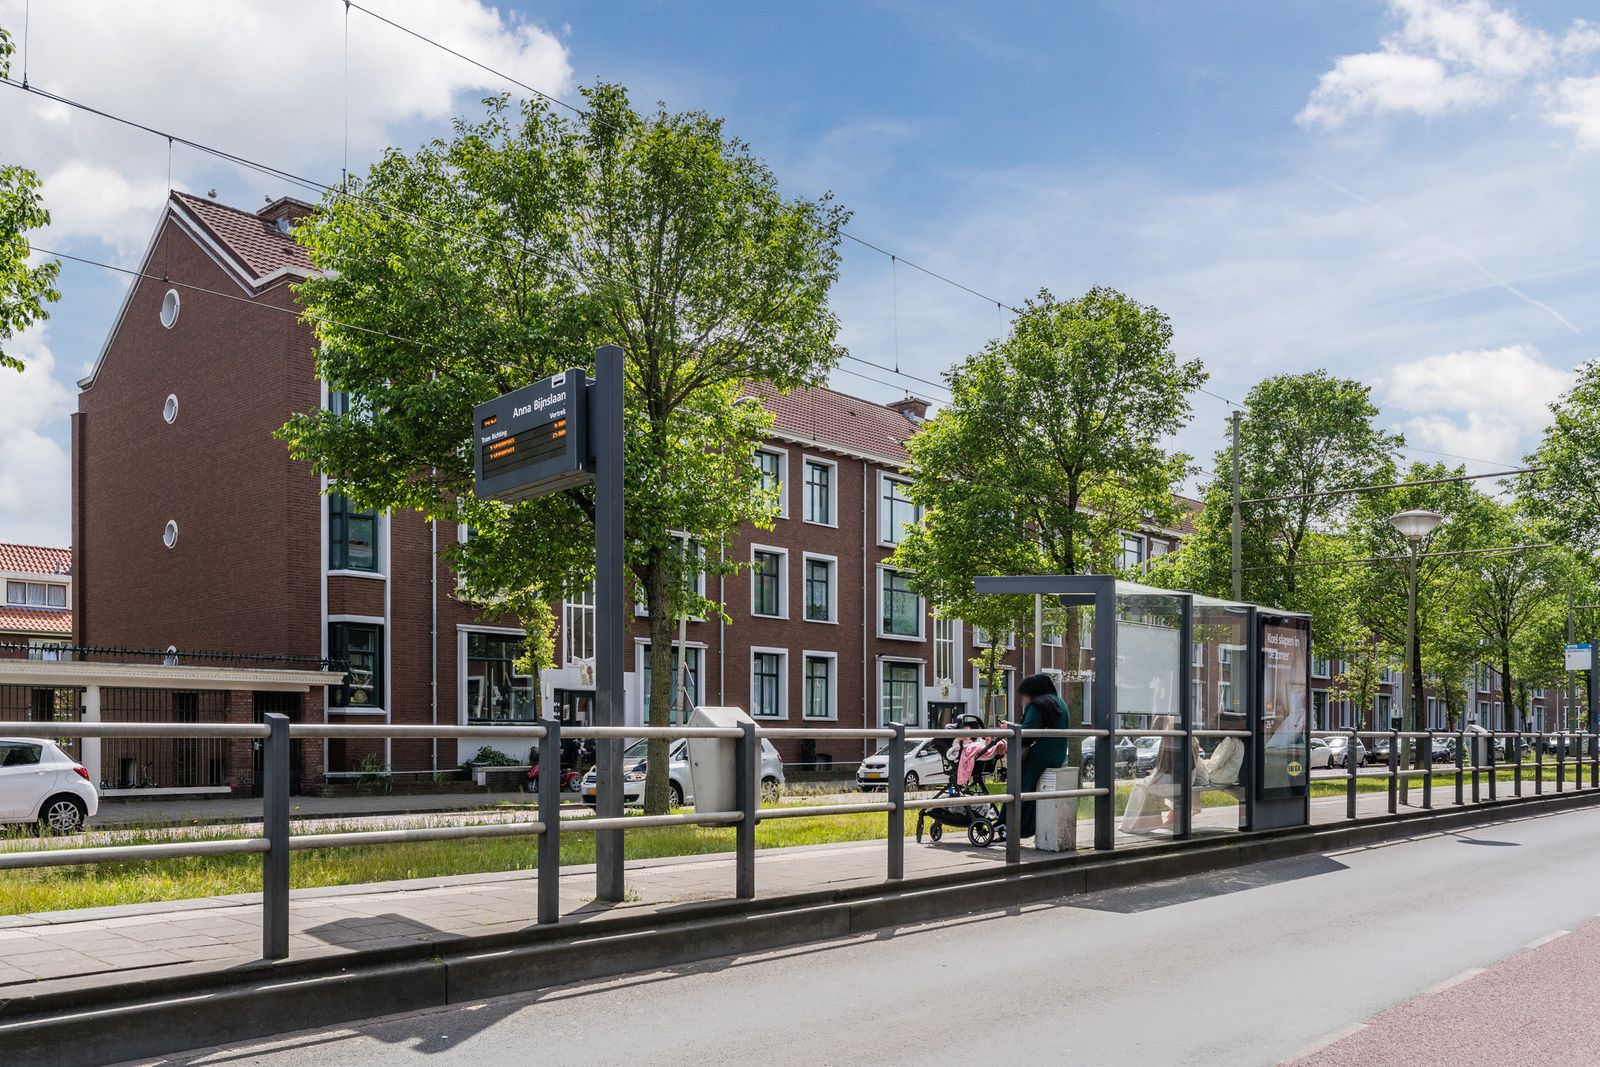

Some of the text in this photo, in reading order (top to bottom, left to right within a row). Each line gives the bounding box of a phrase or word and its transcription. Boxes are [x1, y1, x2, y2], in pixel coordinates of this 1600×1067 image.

[512, 391, 567, 418] Anna Bijnslaan
[549, 408, 567, 419] Vertrek
[1279, 634, 1295, 649] slapen
[1294, 635, 1301, 647] in
[1287, 764, 1302, 773] IKEA
